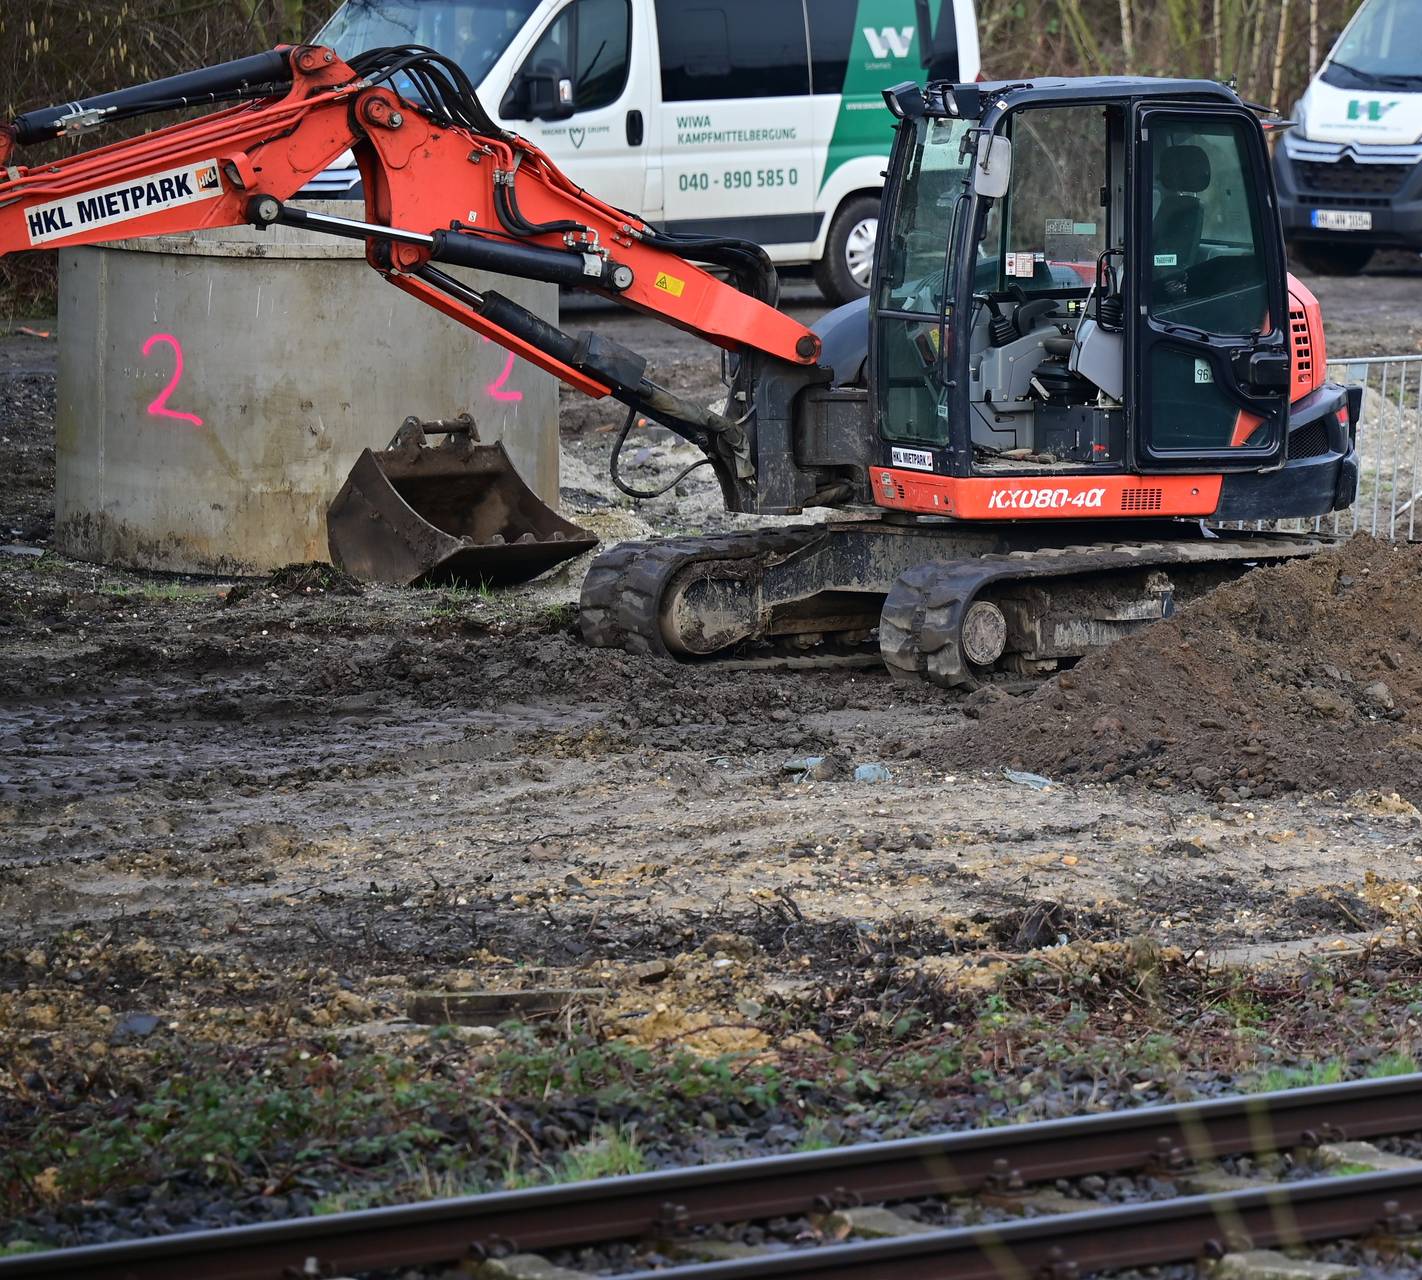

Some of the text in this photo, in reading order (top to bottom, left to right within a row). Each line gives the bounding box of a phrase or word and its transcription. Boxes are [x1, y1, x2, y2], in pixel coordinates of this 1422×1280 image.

[677, 115, 711, 128] WIWA
[678, 128, 796, 144] KAMPFMITTELBERGUNG
[679, 173, 709, 191] 040
[724, 171, 752, 189] 890
[757, 169, 784, 188] 585
[789, 168, 798, 186] 0
[28, 206, 73, 237] HKL
[77, 173, 193, 224] MIETPARK
[142, 333, 204, 426] 2
[1197, 368, 1209, 381] 96
[903, 452, 927, 466] MIETPARK
